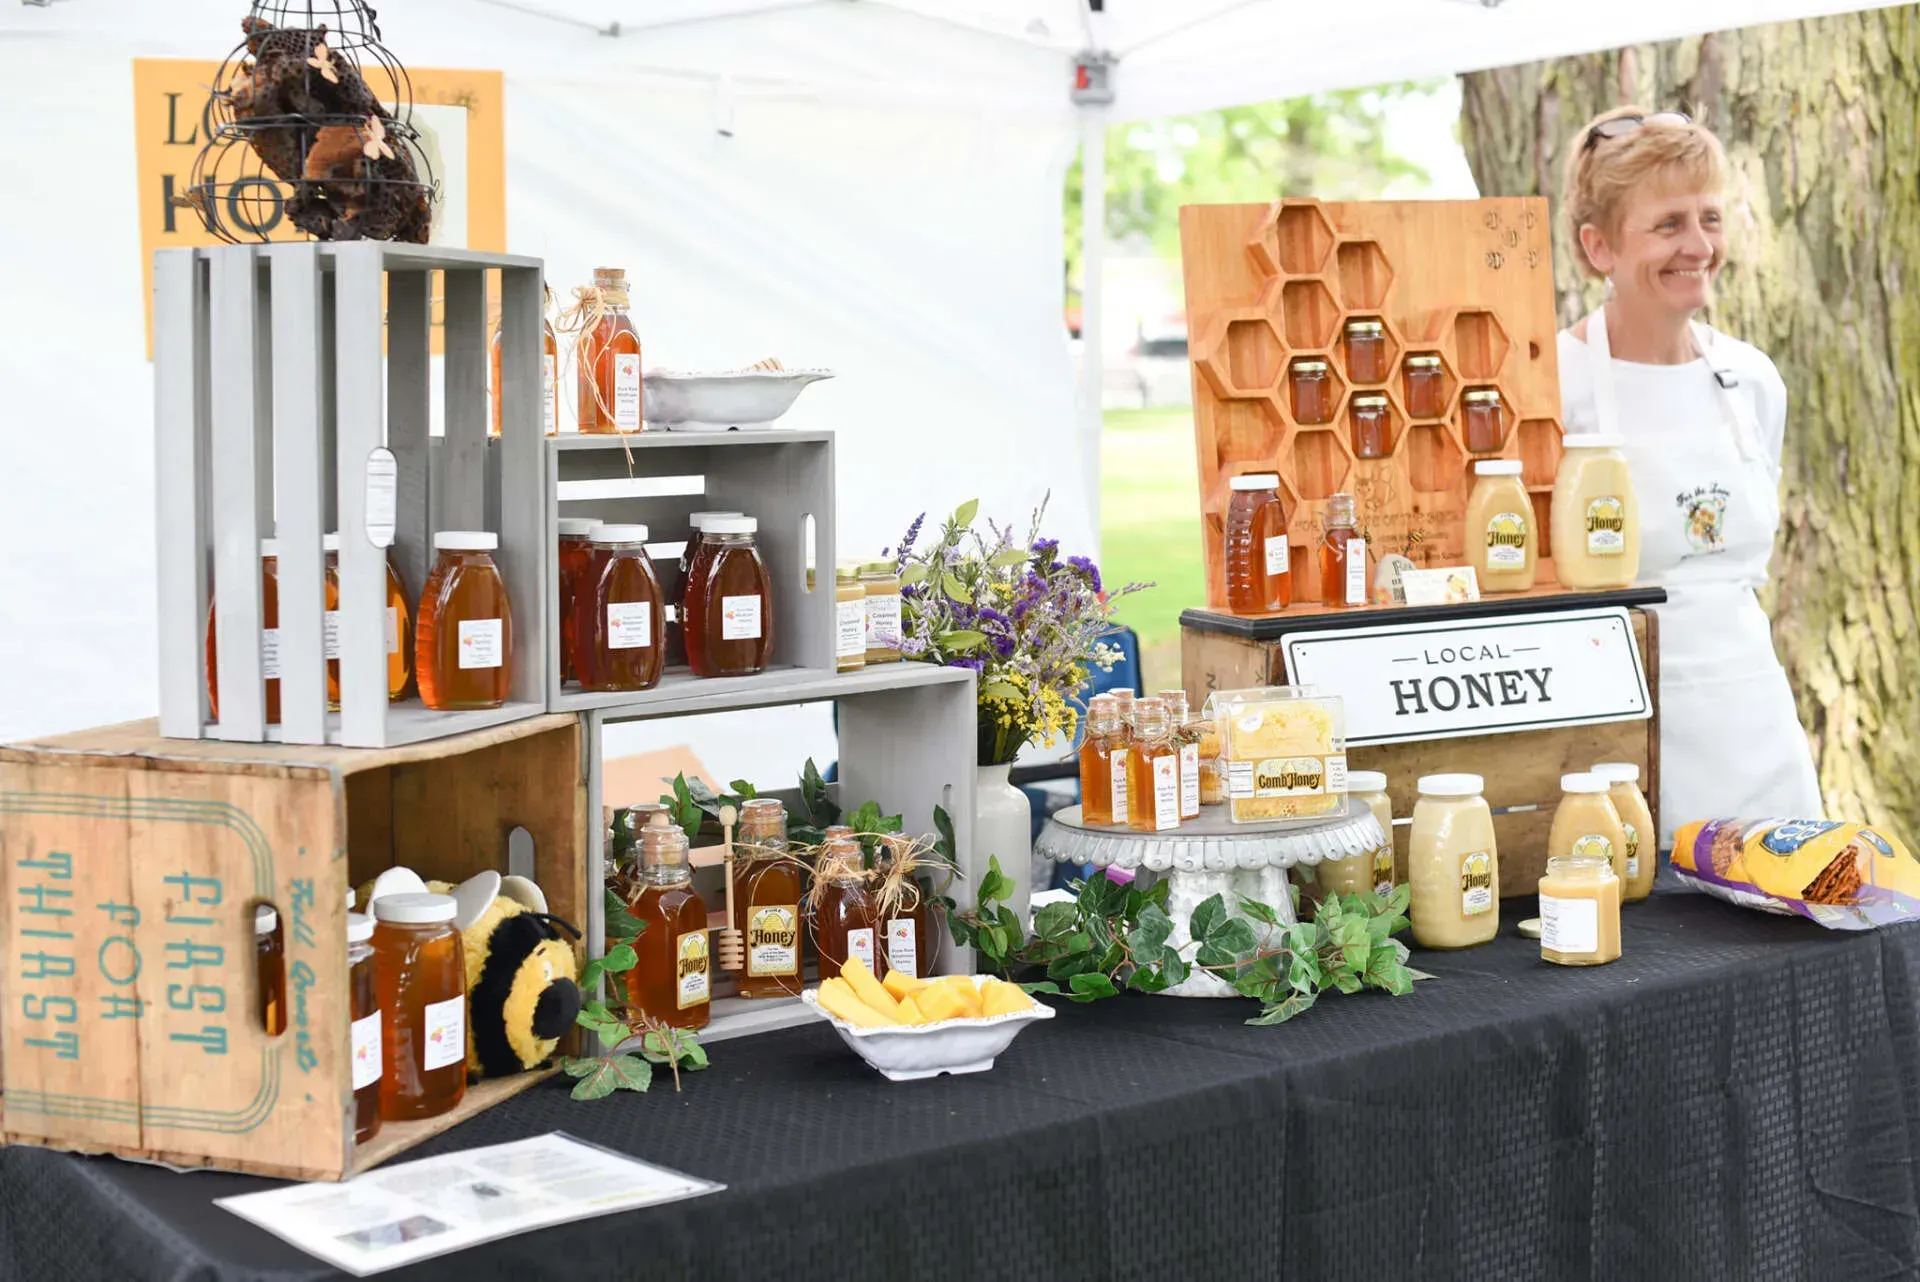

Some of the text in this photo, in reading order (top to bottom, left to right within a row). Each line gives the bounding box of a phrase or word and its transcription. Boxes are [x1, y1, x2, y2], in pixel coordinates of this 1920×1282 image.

[1587, 517, 1624, 532] Honey
[1487, 531, 1525, 548] Honey
[1425, 644, 1511, 665] LOCAL
[1390, 667, 1553, 716] HONEY
[1258, 774, 1287, 789] Comb
[1286, 773, 1321, 790] Honey
[1462, 872, 1491, 892] Honey
[290, 878, 317, 949] Full
[749, 929, 796, 948] Honey
[16, 851, 80, 1061] THIRST
[95, 899, 145, 1020] FOR
[162, 870, 229, 1055] FIRST
[679, 955, 708, 979] Honey
